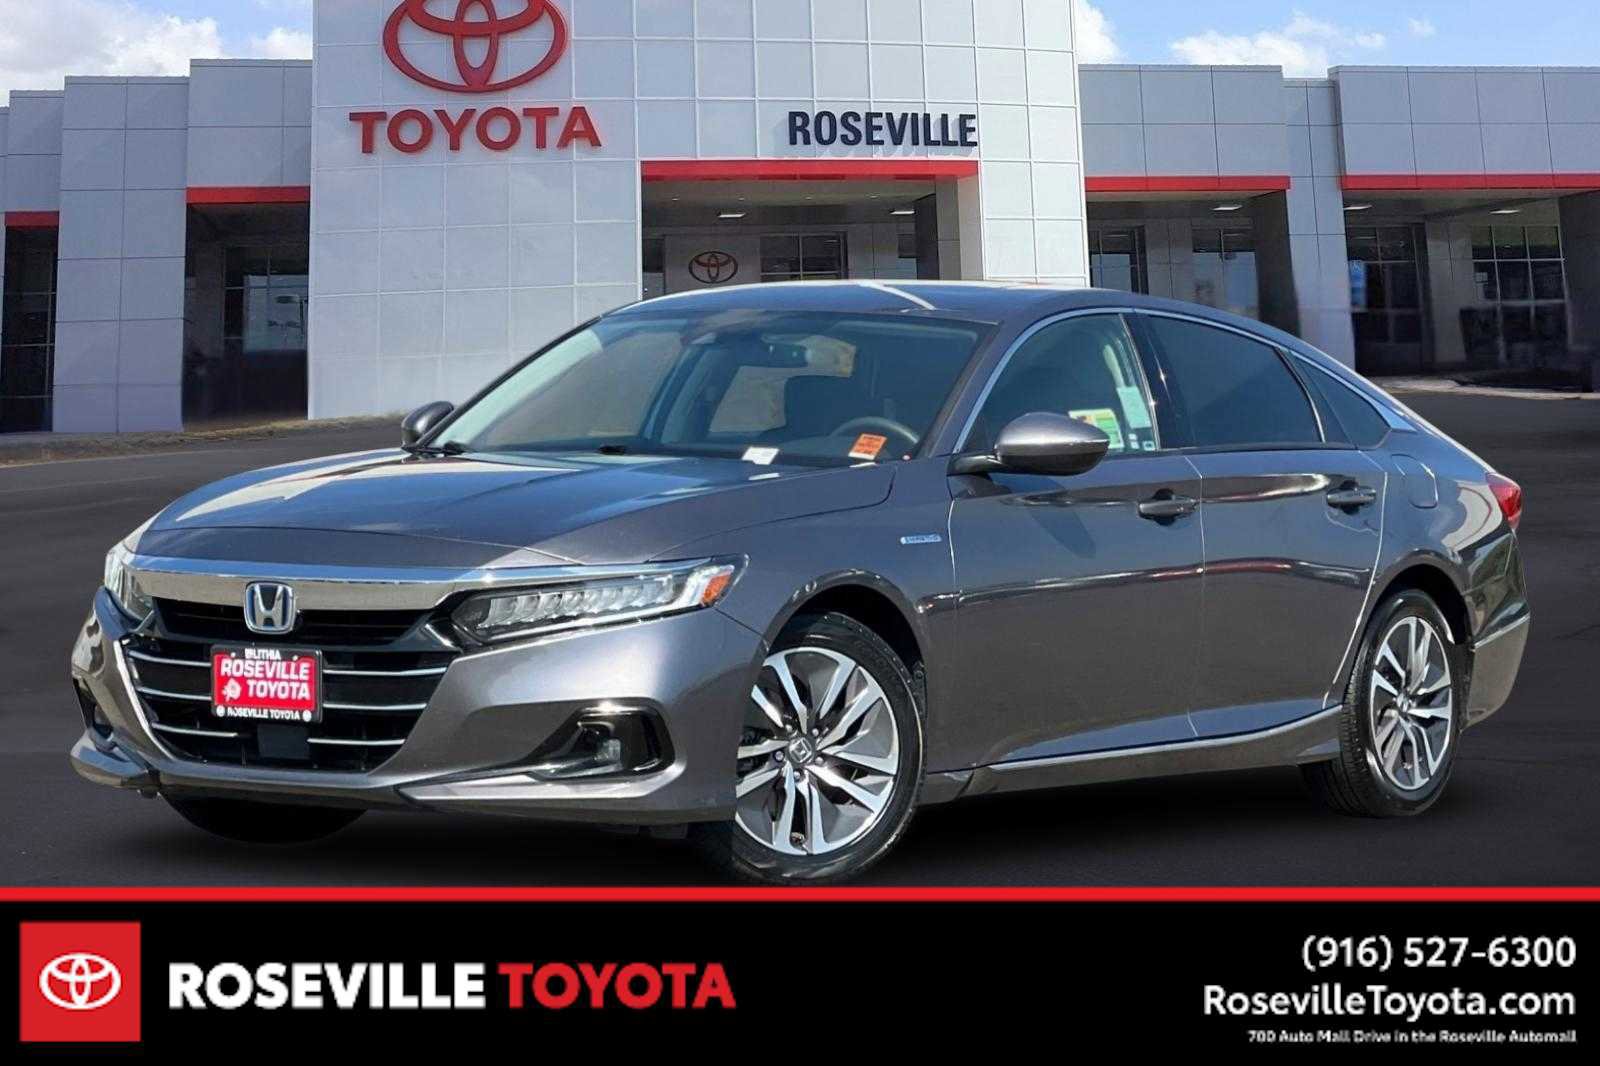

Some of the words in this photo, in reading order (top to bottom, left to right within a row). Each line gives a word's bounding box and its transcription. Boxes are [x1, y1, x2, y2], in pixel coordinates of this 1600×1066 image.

[349, 106, 602, 154] TOYOTA
[788, 110, 978, 147] ROSEVILLE
[220, 658, 311, 680] ROSEVILLE
[246, 680, 311, 700] TOYOTA
[227, 707, 269, 719] ROSEVILLE
[270, 709, 300, 720] TOYOTA
